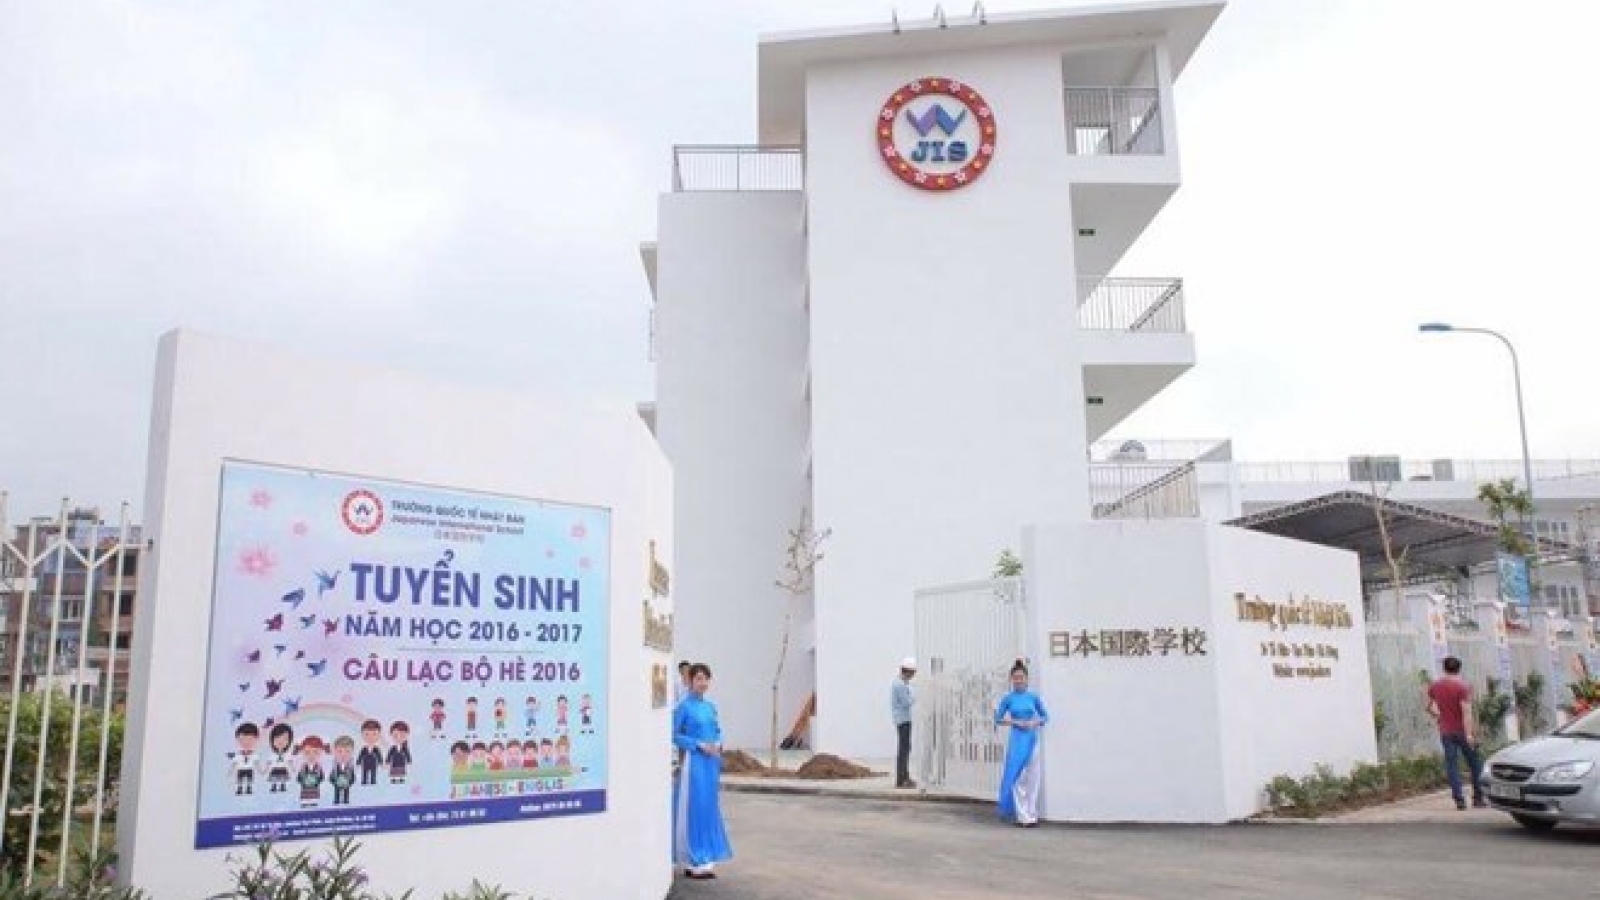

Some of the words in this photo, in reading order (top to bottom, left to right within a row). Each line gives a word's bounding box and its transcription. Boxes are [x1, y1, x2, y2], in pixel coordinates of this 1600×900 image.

[911, 141, 968, 163] JIS
[350, 549, 480, 607] TUYỂN
[494, 574, 580, 612] SINH
[346, 611, 401, 637] NĂM
[409, 618, 462, 645] HỌC
[469, 621, 519, 642] 2016
[536, 623, 583, 642] 2017
[1049, 628, 1207, 658] 日本国際学校
[343, 653, 398, 681] CÂU
[407, 660, 453, 687] LẠC
[460, 655, 493, 687] BỘ
[501, 656, 526, 681] HÈ
[533, 662, 581, 681] 2016
